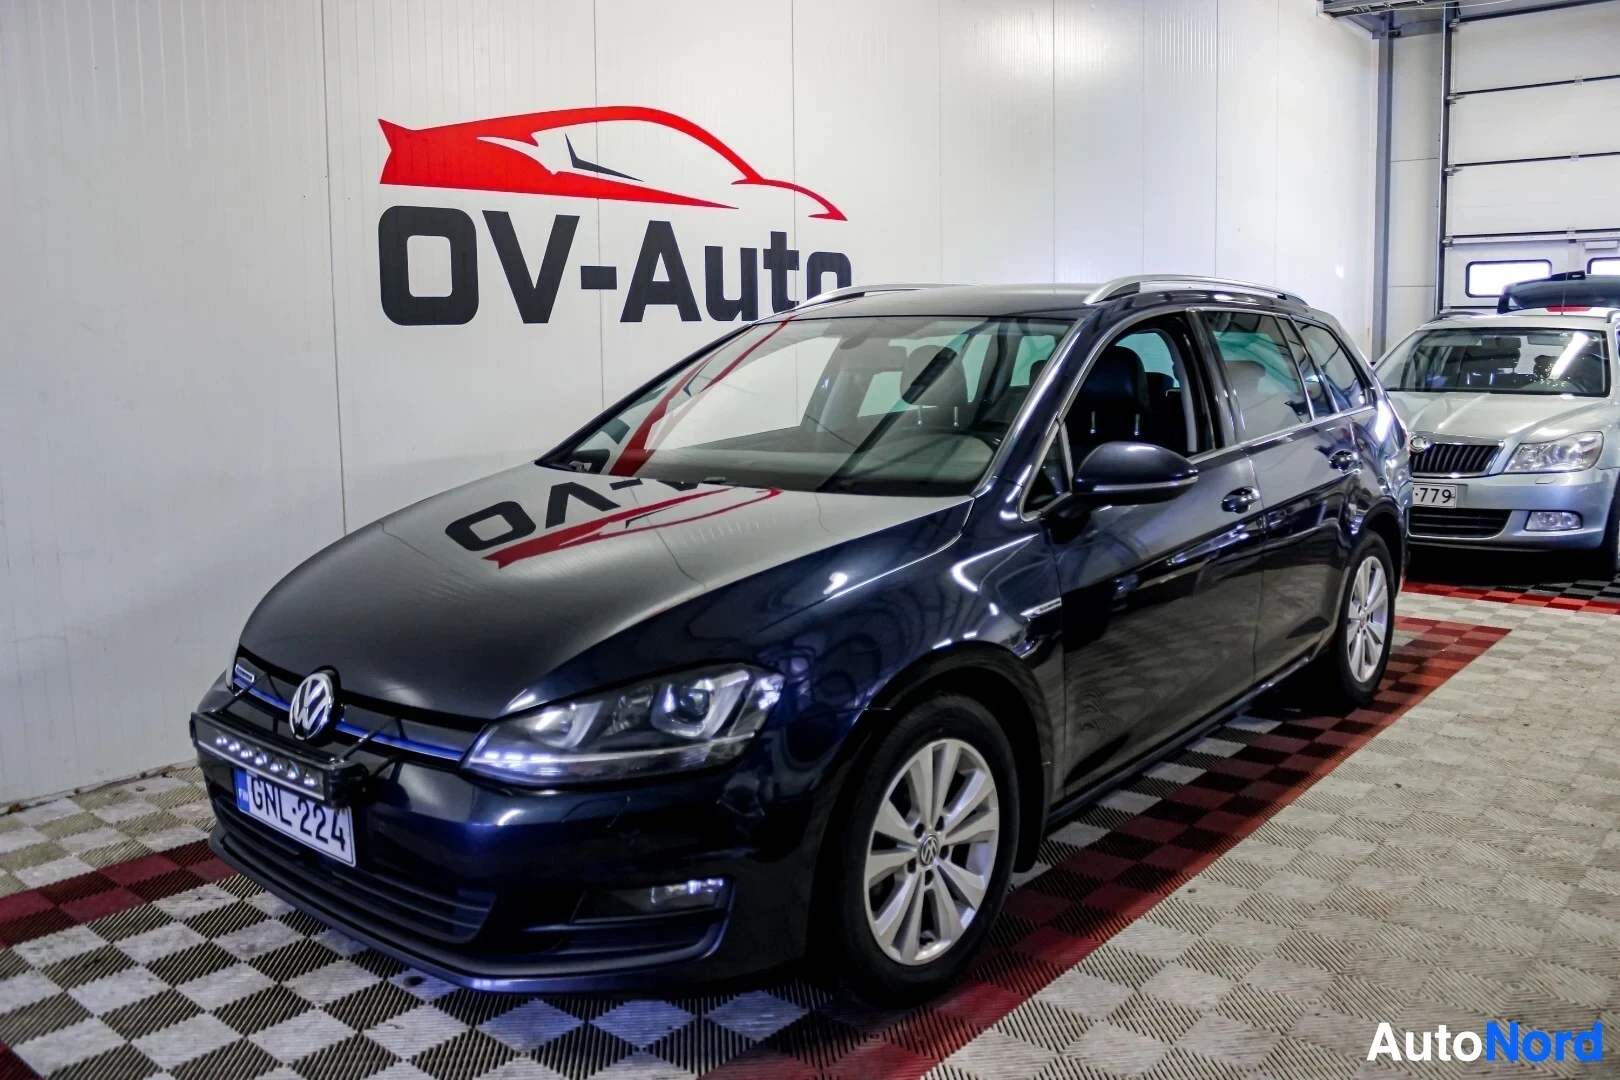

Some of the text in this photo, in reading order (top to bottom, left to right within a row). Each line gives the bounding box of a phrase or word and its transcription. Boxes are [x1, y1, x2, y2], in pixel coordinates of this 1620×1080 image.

[378, 205, 852, 326] OV-Auto
[1413, 487, 1452, 503] -779
[251, 778, 345, 851] GNL-224
